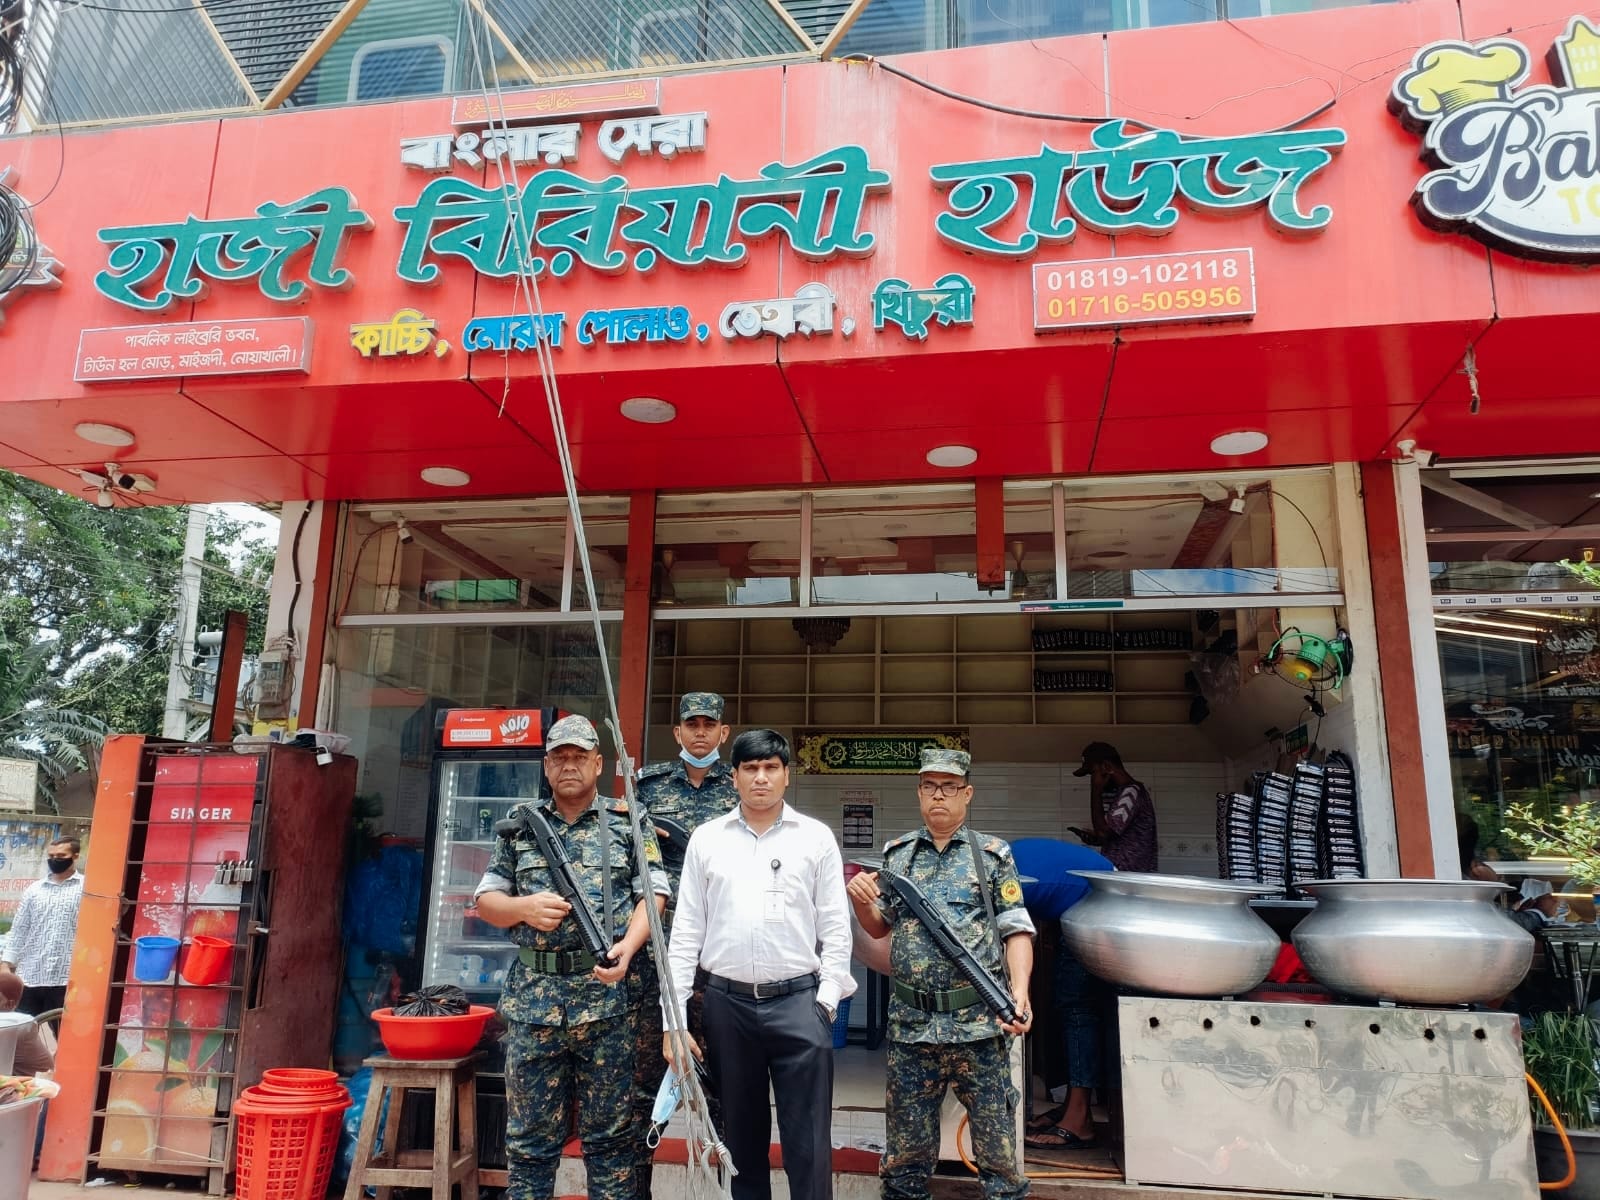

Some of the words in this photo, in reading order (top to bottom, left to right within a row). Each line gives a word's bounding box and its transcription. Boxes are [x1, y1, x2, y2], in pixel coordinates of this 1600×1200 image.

[401, 123, 581, 171] বাংলার
[598, 111, 708, 165] সেরা
[94, 186, 371, 311] হাজী
[393, 144, 891, 283] বিরিয়ানী
[929, 118, 1347, 256] হাউজ
[1047, 259, 1239, 291] 01819-102118
[1048, 286, 1243, 318] 01716-505956
[124, 330, 171, 348] পাবলিক
[174, 326, 222, 346] লাইব্রেরি
[225, 327, 260, 343] ভবন,
[83, 355, 115, 373] টাউন
[118, 358, 137, 372] হল
[178, 348, 227, 367] মাইজদী,
[170, 807, 232, 820] SINGER
